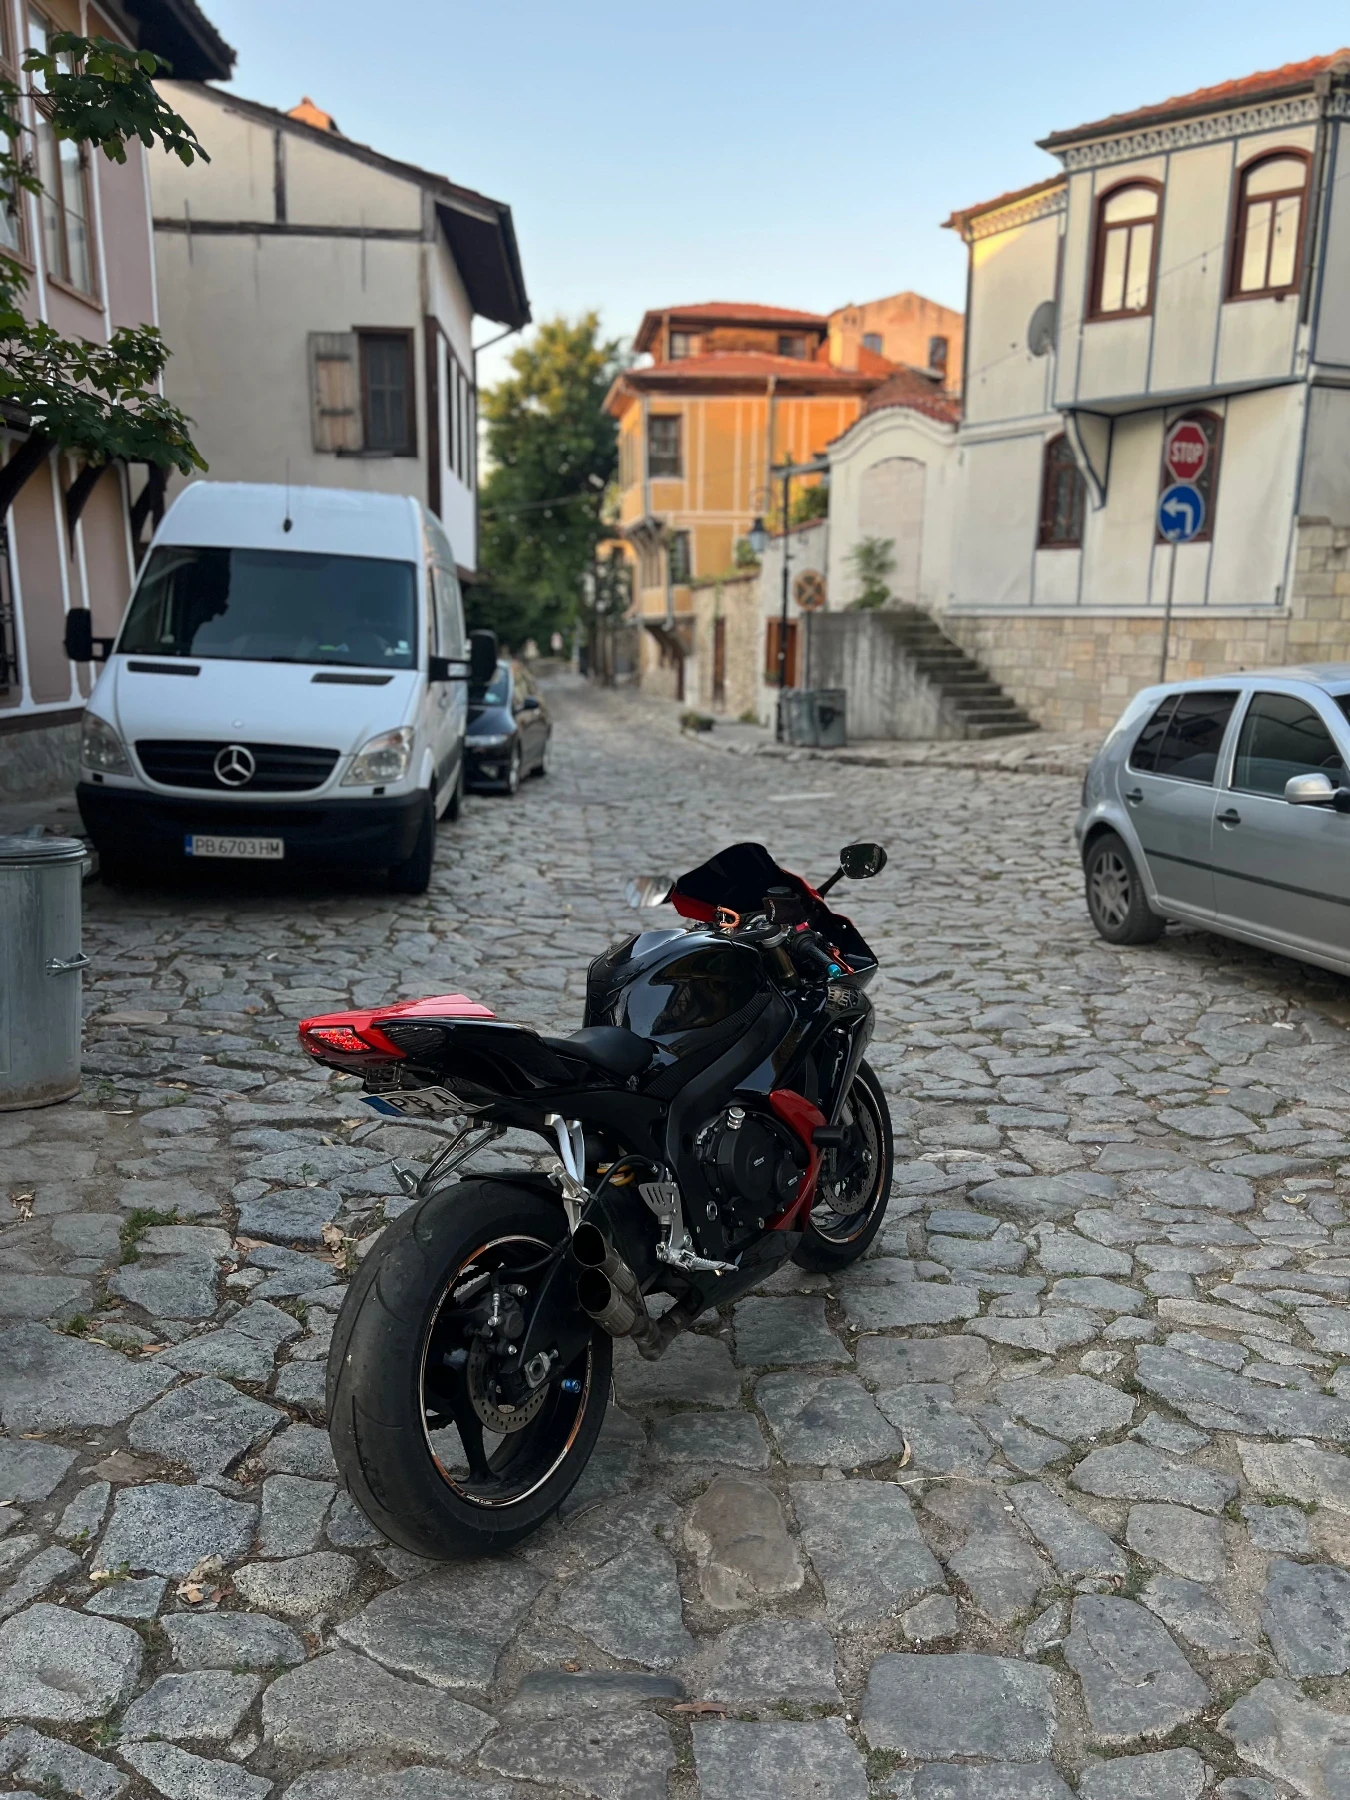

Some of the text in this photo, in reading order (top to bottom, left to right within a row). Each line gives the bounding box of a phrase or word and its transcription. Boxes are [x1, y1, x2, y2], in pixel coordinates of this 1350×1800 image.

[1171, 441, 1205, 464] STOP
[195, 838, 215, 853] PB
[218, 840, 256, 855] 6703
[386, 1095, 436, 1112] PB
[432, 1092, 457, 1106] A
